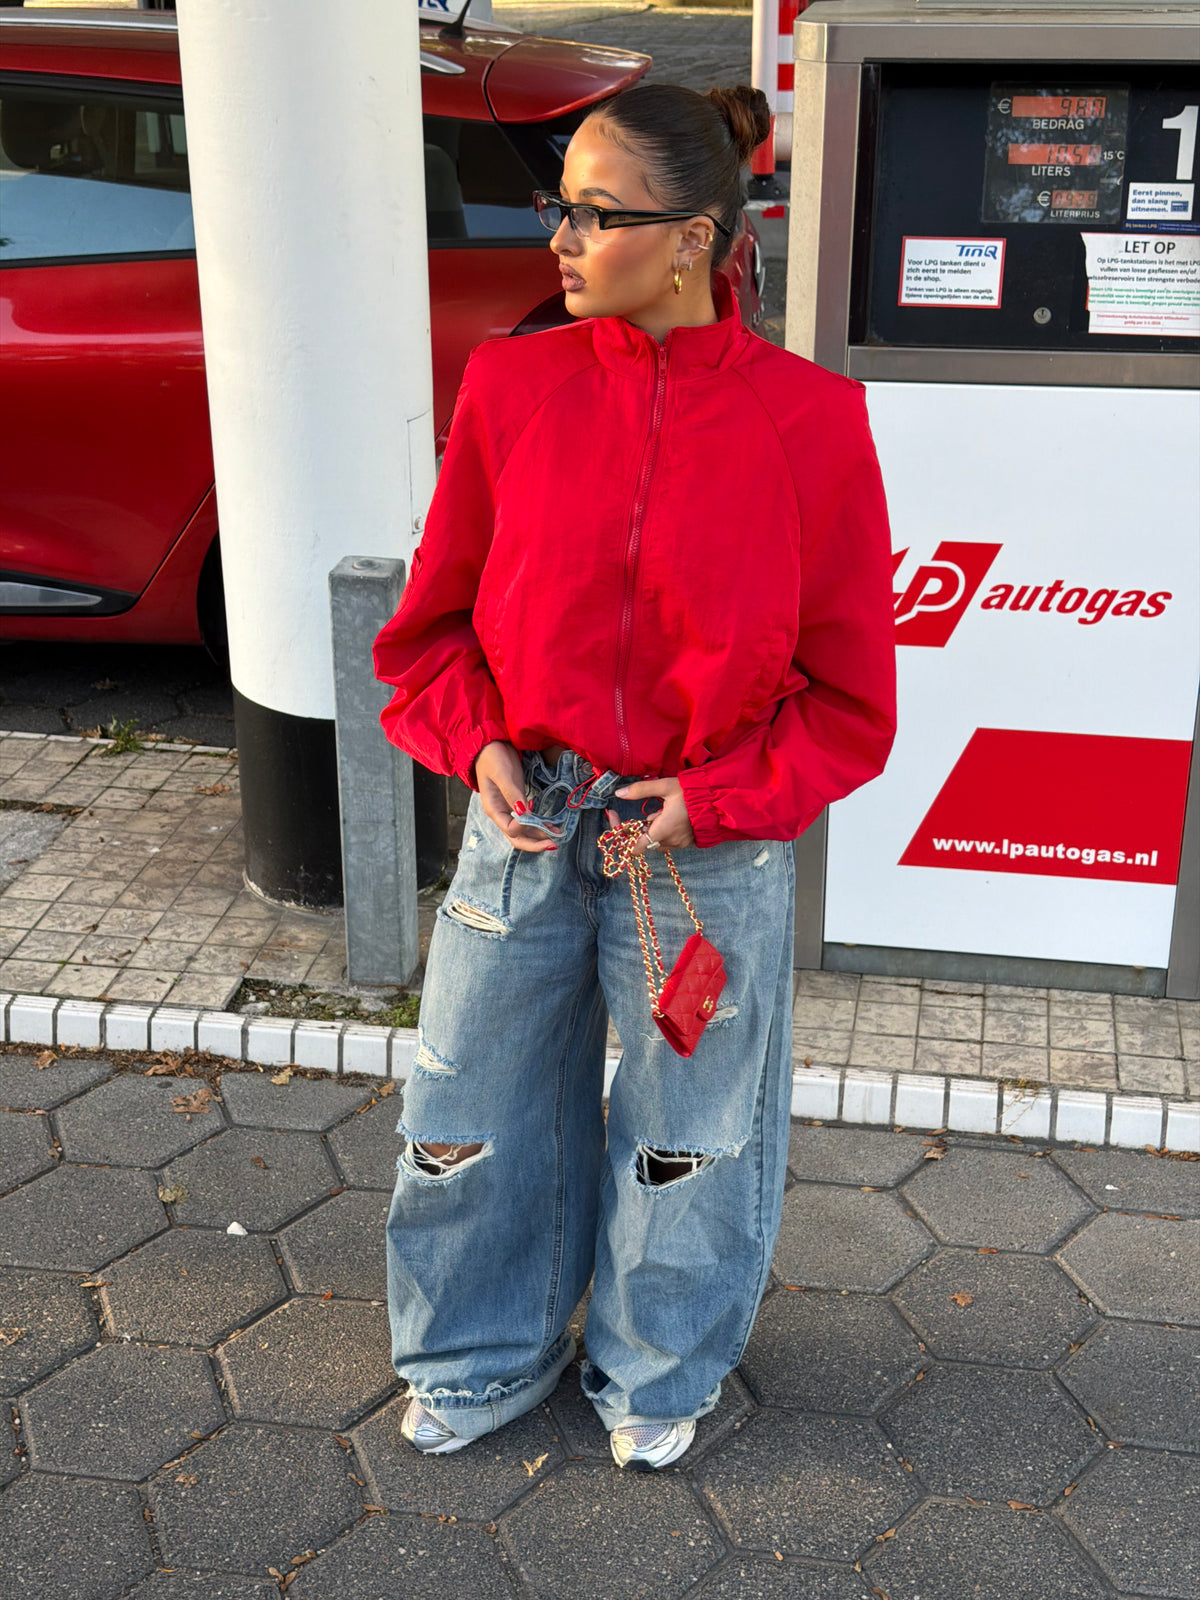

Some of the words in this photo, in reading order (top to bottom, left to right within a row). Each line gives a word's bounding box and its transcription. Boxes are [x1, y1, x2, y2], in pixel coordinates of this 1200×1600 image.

[1032, 119, 1085, 130] BEDRAG
[1162, 105, 1199, 180] 1
[1031, 165, 1071, 177] LITERS
[1147, 197, 1169, 205] slang
[1049, 209, 1101, 218] LITERPRIJS
[956, 244, 998, 260] TinQ
[1124, 240, 1151, 254] LET
[1154, 241, 1176, 255] OP
[940, 259, 962, 267] tanken
[1096, 257, 1106, 265] Op
[1164, 258, 1175, 266] het
[980, 579, 1173, 625] autogas
[932, 837, 1159, 867] www.lpautogas.nl
